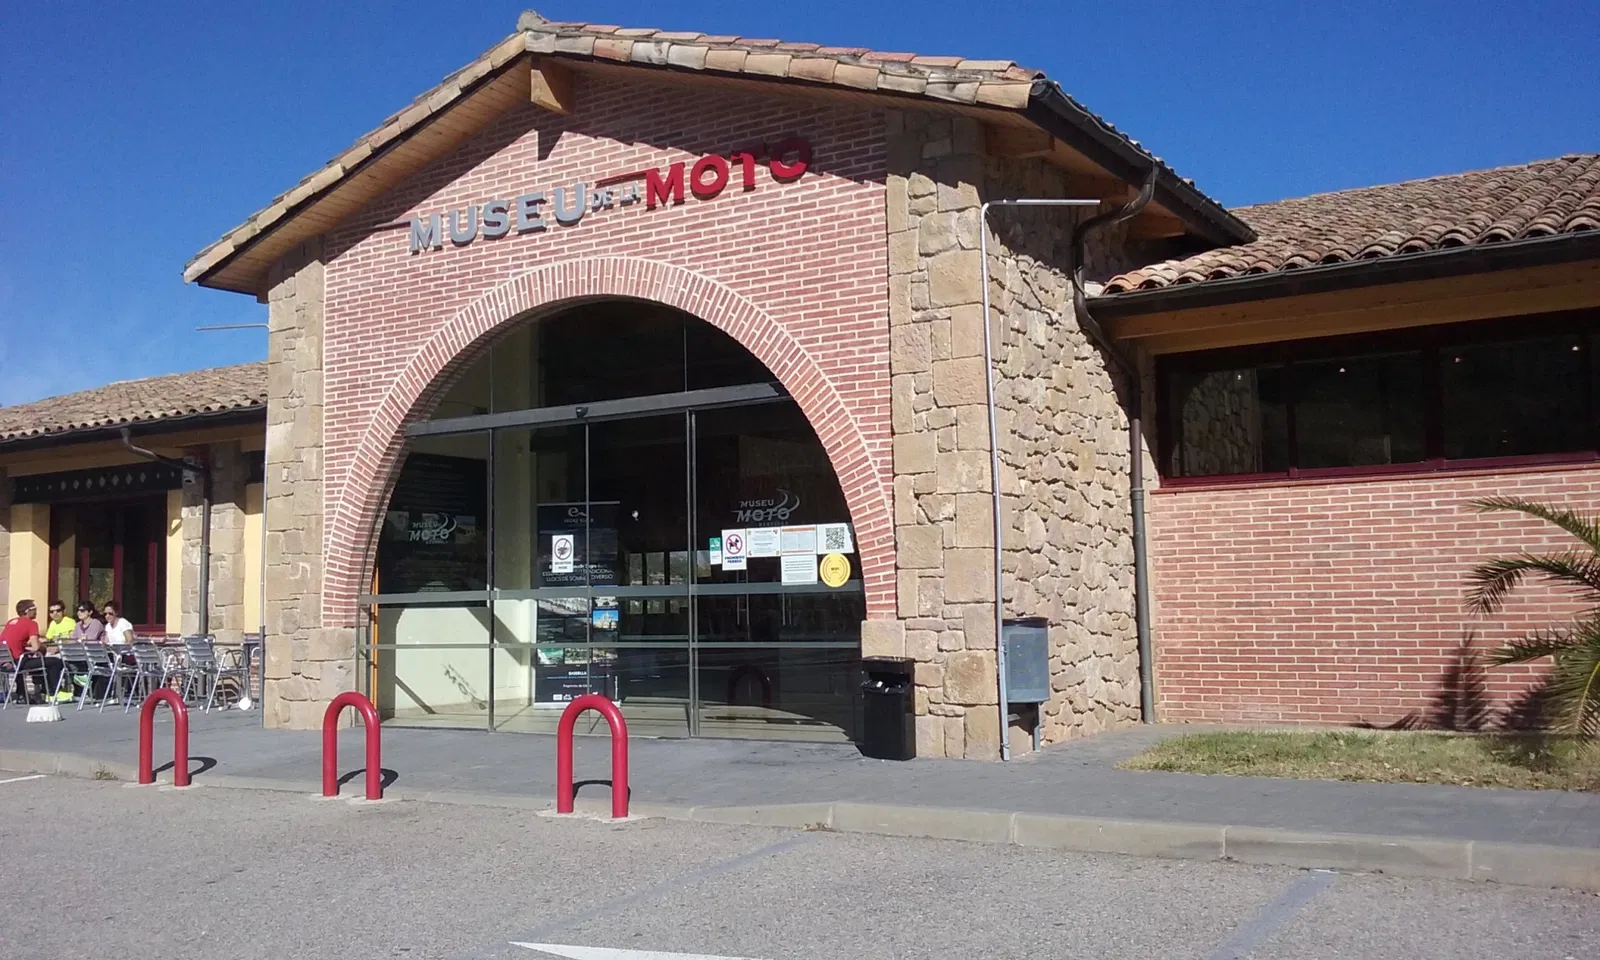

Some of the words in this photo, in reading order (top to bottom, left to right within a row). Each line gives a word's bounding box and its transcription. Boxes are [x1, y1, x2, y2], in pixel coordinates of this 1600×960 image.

[409, 182, 588, 254] MUSEU
[591, 189, 614, 212] DE
[619, 182, 642, 207] LA
[642, 136, 813, 211] MOTO
[738, 498, 774, 508] MUSEU
[732, 507, 790, 523] MOTO
[412, 519, 438, 528] MUSEU
[407, 528, 449, 542] MOTO
